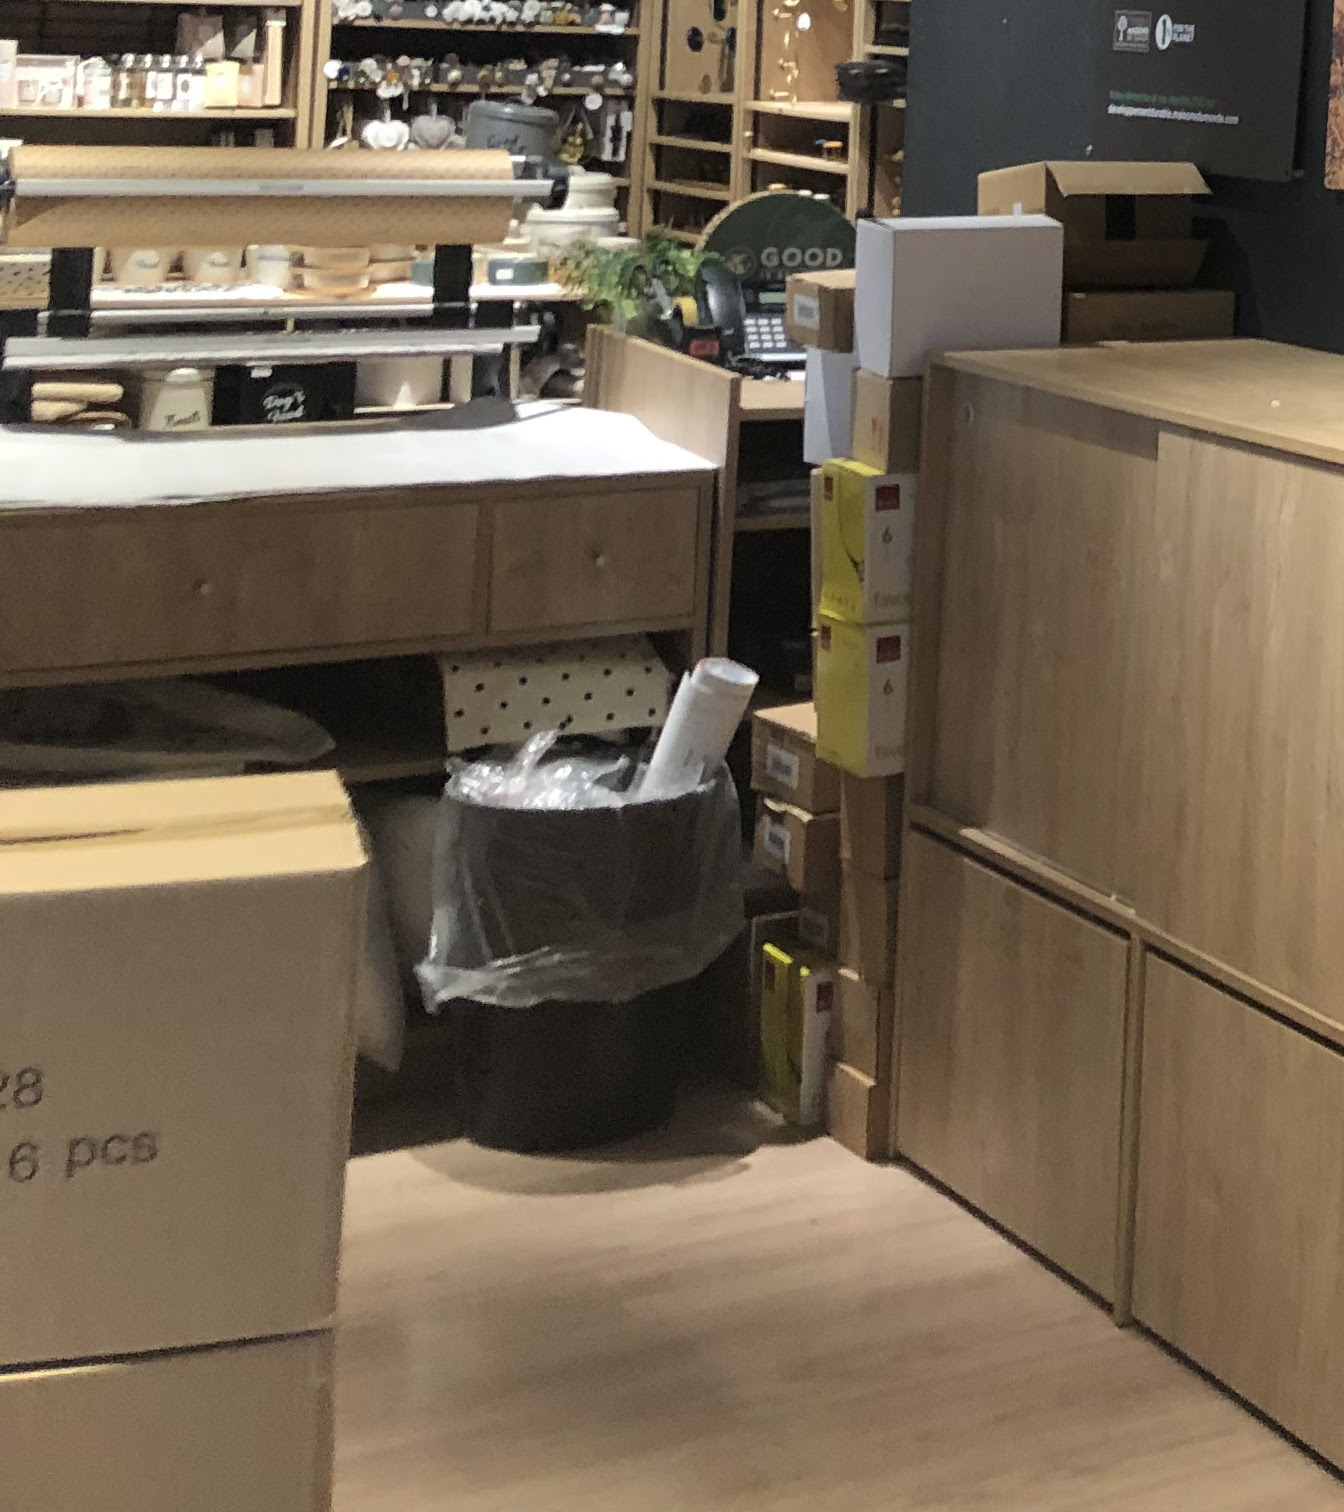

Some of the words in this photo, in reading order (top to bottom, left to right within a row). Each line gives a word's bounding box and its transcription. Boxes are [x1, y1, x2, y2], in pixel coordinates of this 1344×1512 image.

[760, 246, 843, 268] GOOD
[8, 1140, 39, 1184] 6
[64, 1130, 159, 1179] pcs
